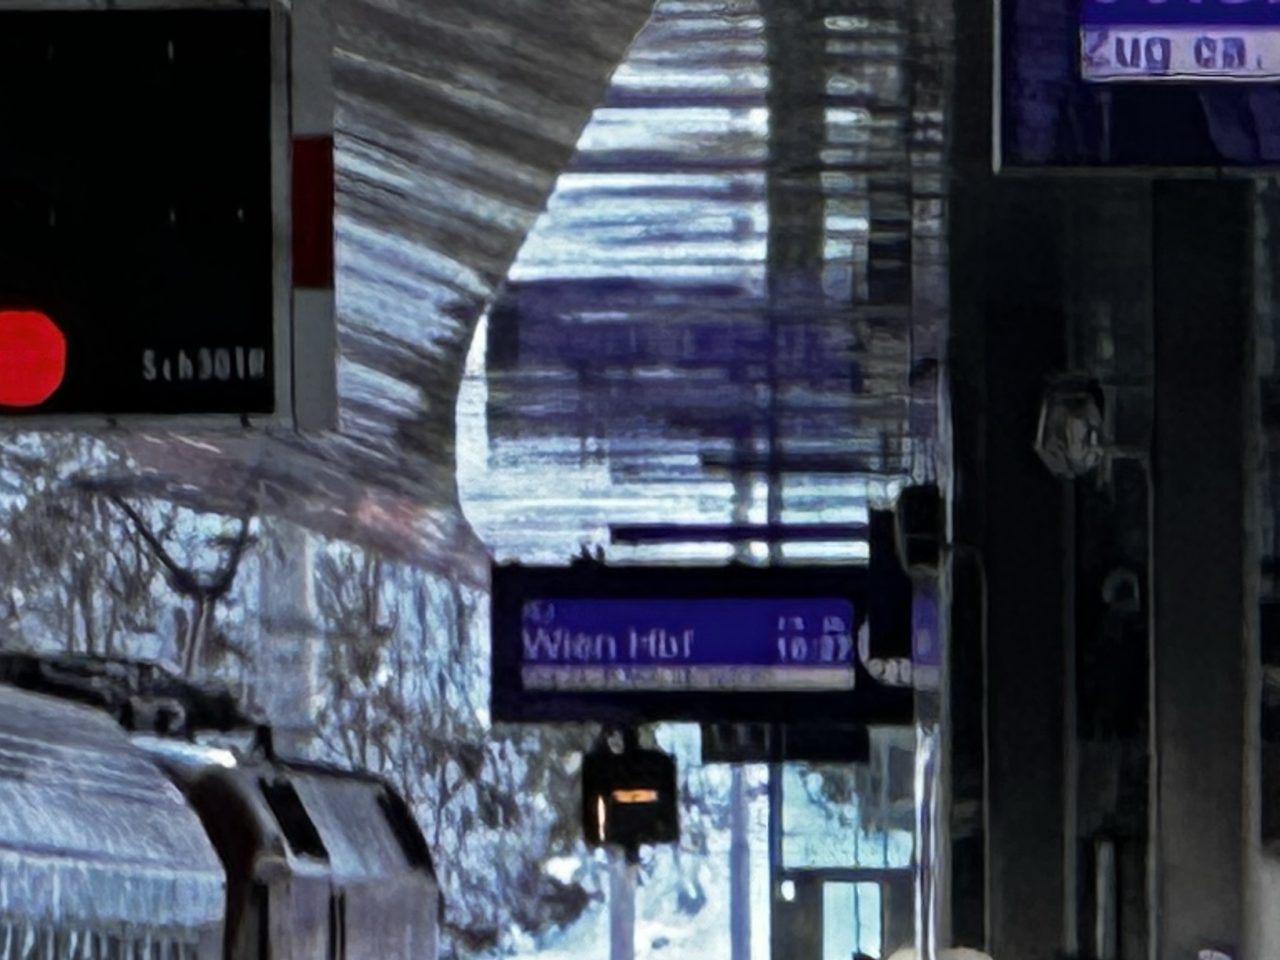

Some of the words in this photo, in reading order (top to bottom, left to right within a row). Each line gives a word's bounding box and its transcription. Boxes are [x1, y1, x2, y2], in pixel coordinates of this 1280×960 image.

[1082, 28, 1171, 72] Zug
[522, 626, 617, 660] Wien
[629, 625, 694, 659] Hbf
